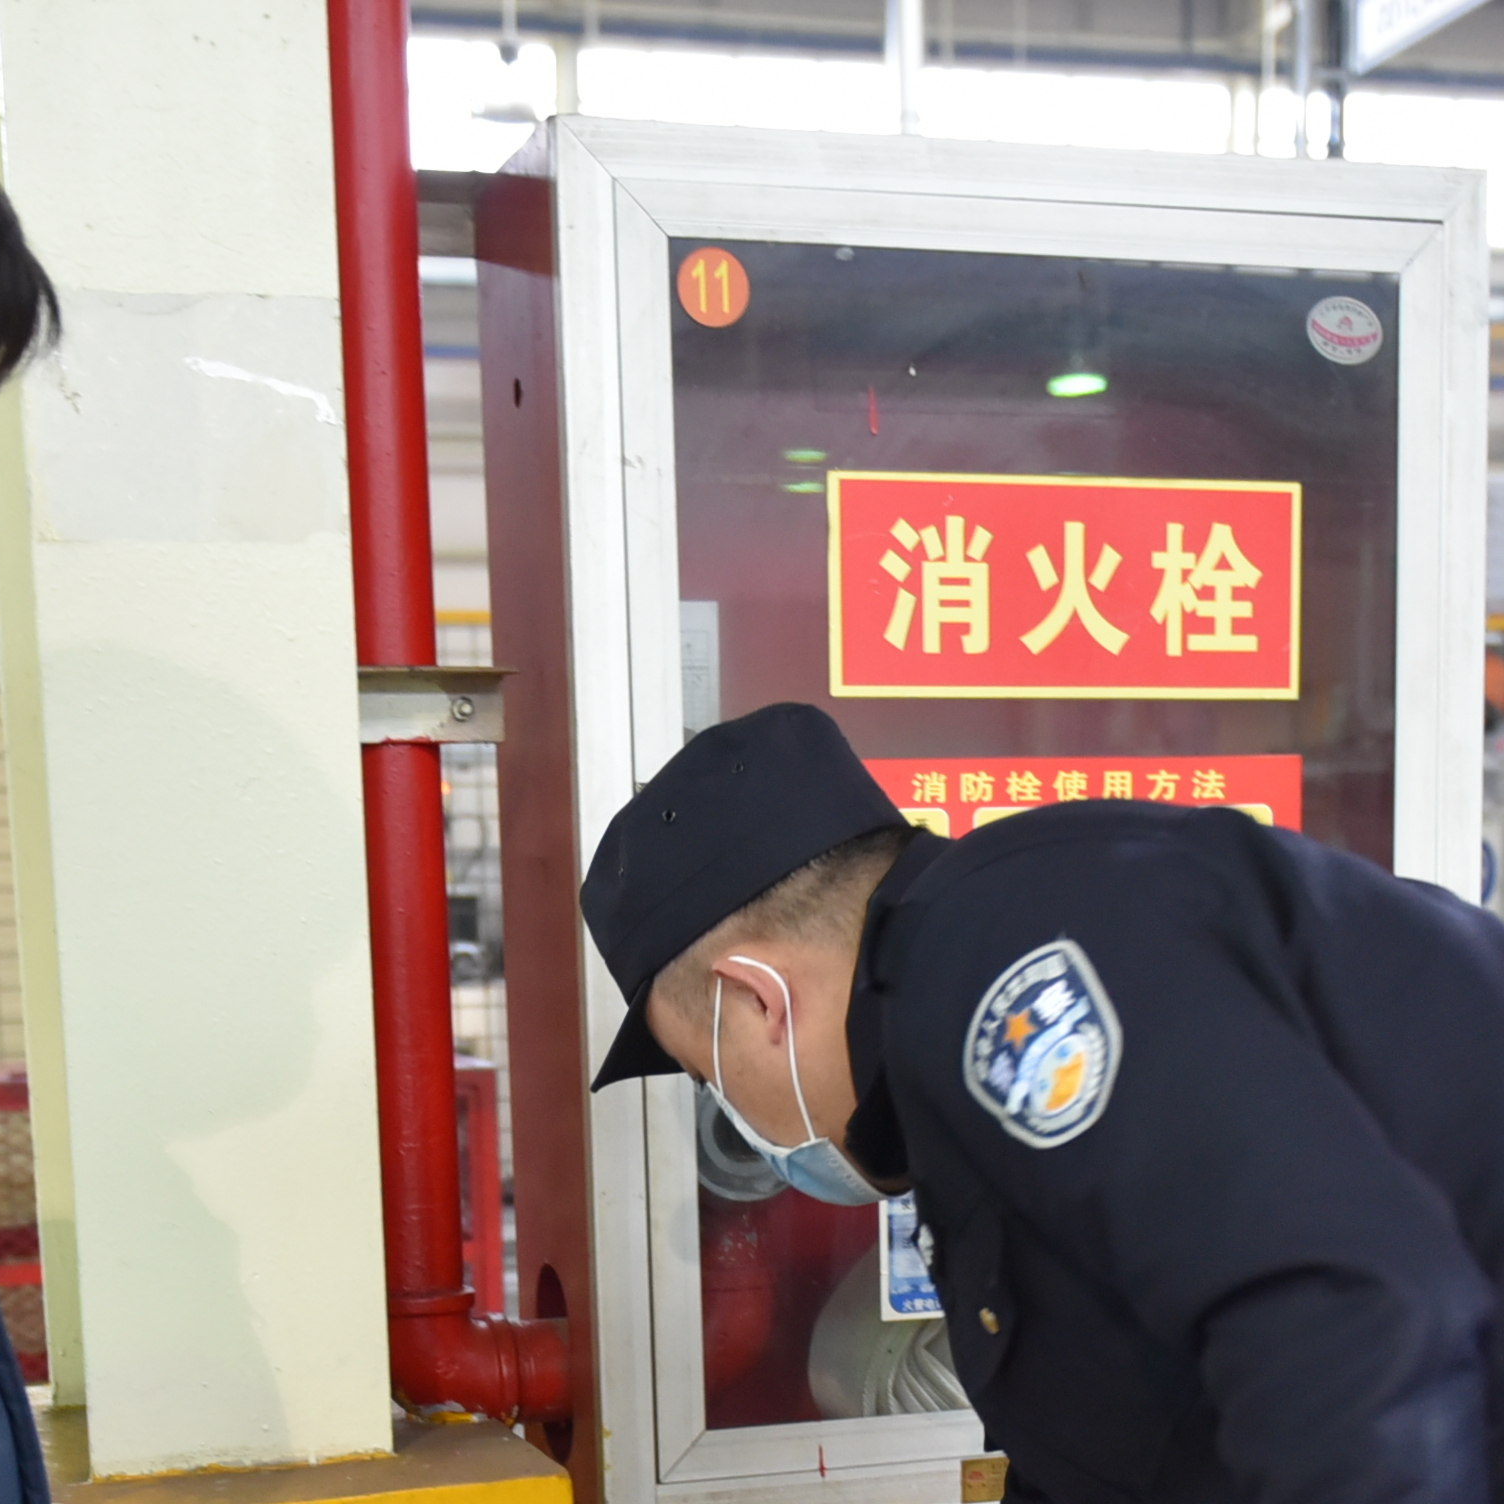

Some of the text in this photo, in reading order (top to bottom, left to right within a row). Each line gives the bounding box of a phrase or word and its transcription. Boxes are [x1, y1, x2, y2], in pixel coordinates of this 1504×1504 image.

[691, 258, 731, 314] 11
[878, 514, 1264, 658] 消火栓
[911, 769, 1226, 803] 消防栓使用方法
